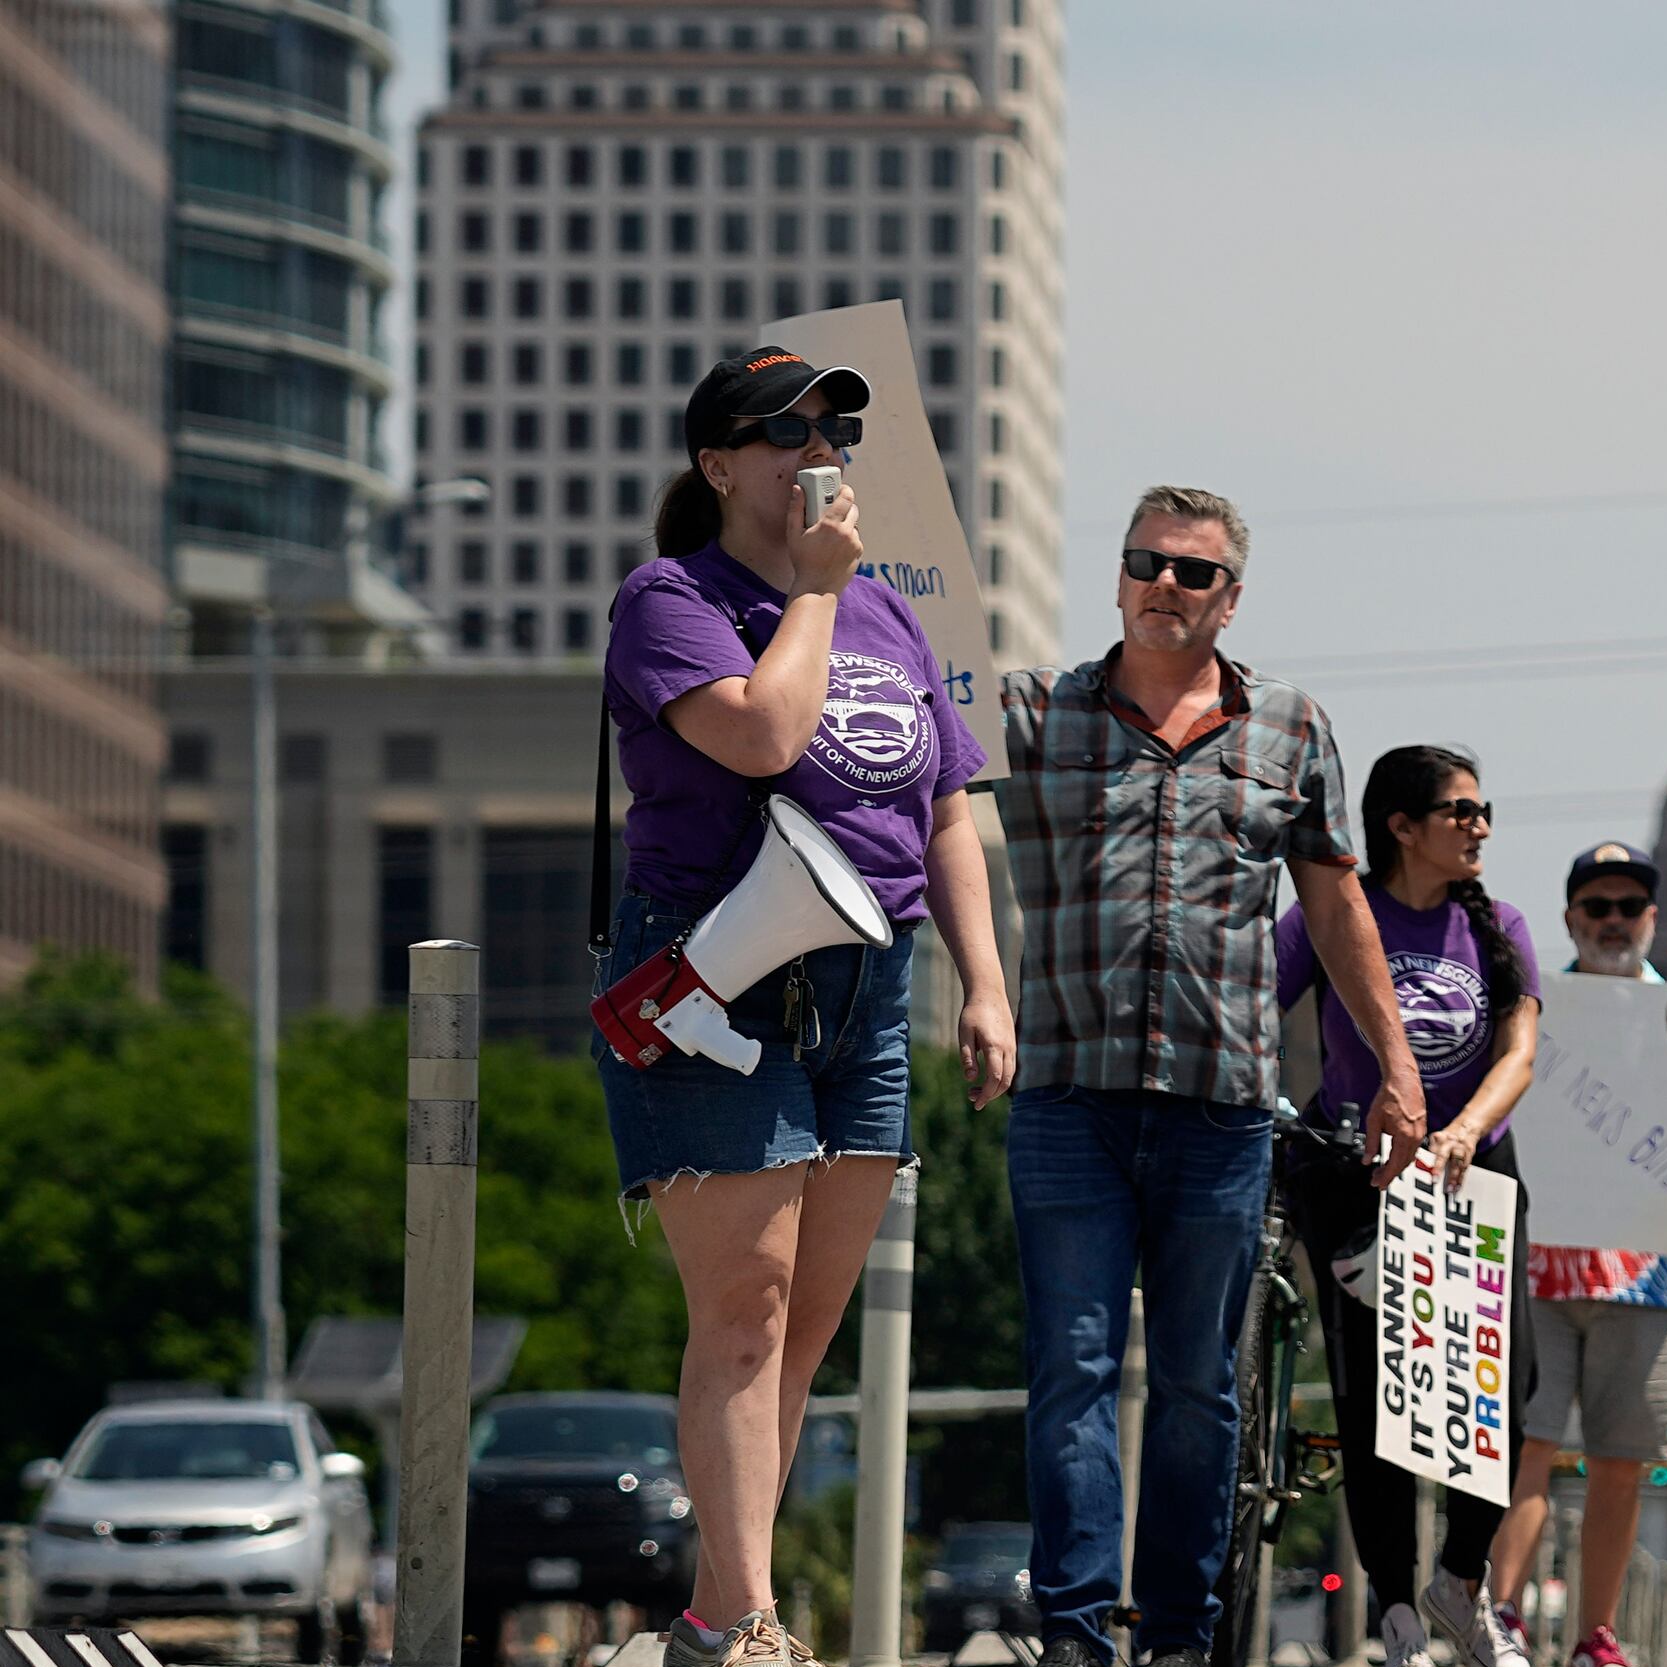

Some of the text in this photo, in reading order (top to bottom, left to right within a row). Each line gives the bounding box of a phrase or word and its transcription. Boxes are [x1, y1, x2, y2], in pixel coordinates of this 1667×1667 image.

[1411, 1247, 1435, 1352] YOU.
[1445, 1199, 1475, 1480] YOU'RE THE
[1474, 1222, 1507, 1461] PROBLEM
[1411, 1358, 1435, 1461] IT'S
